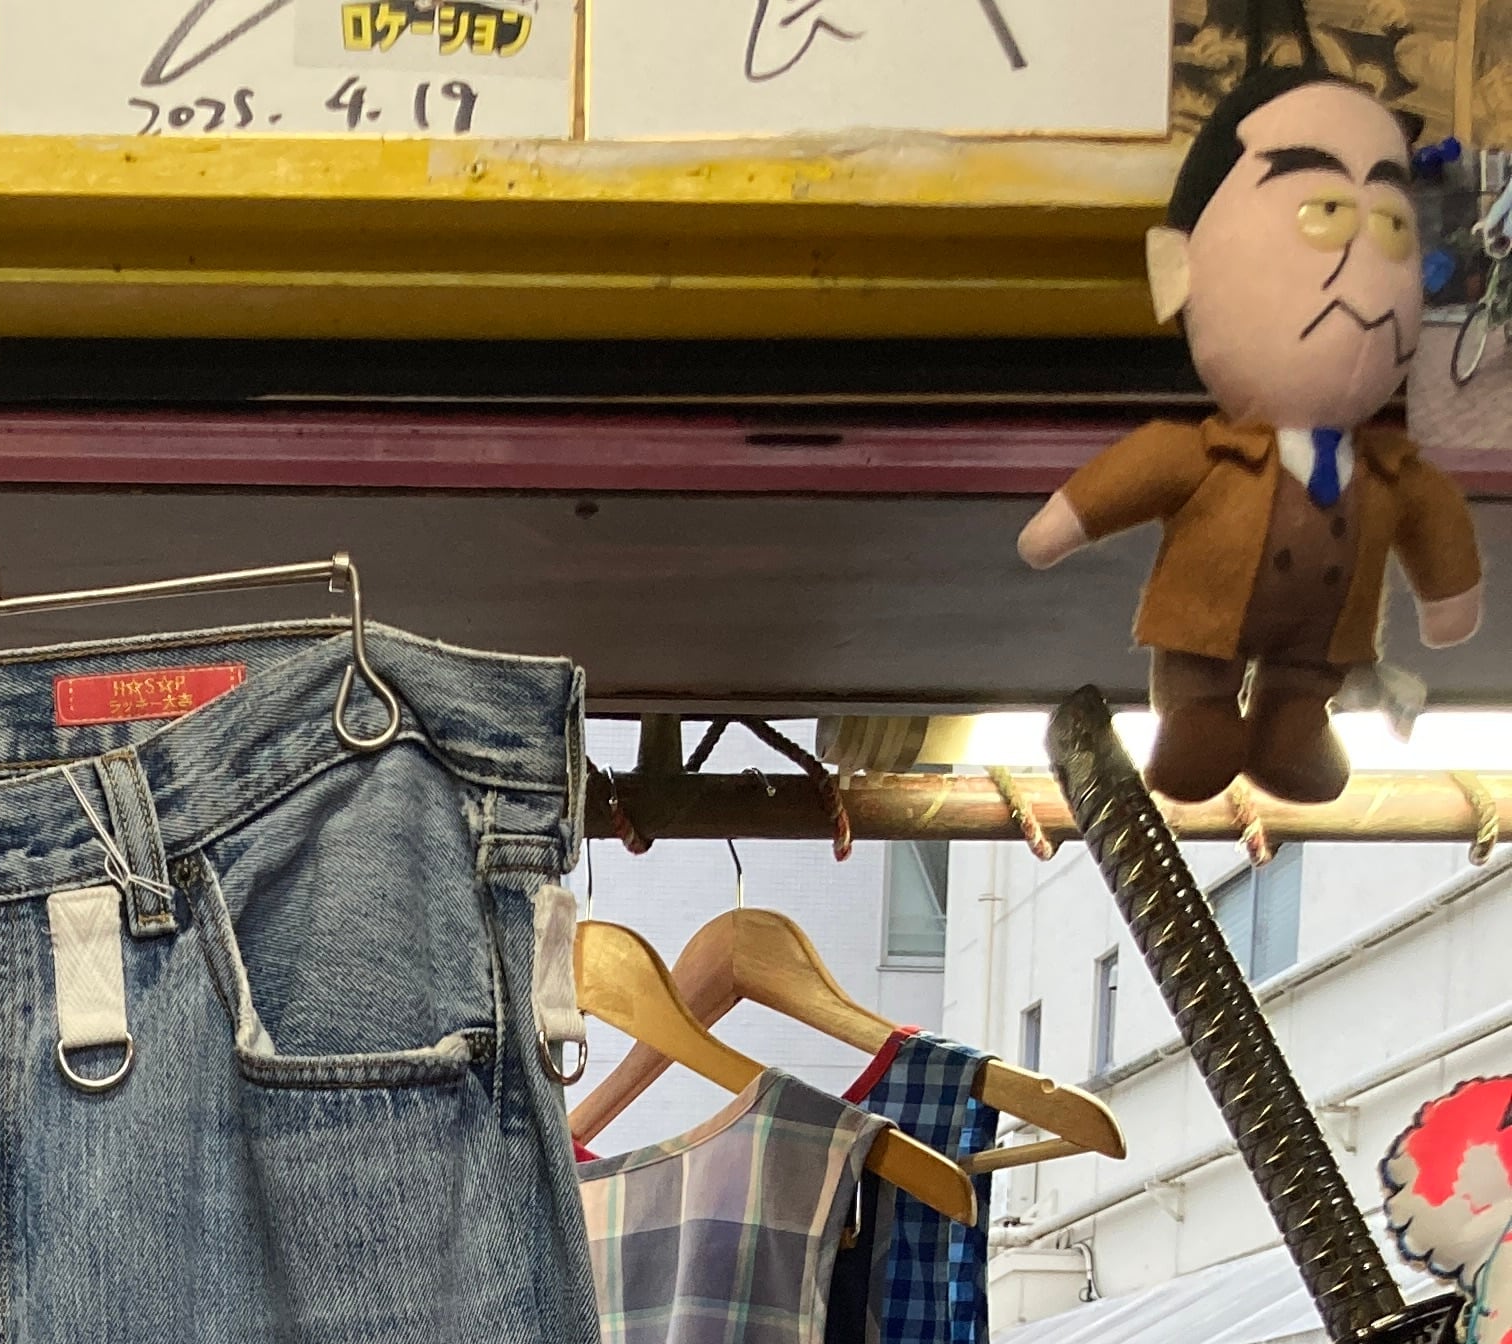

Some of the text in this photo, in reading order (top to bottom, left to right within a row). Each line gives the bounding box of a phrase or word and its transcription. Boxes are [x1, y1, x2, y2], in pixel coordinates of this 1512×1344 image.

[341, 2, 533, 58] ロケーション
